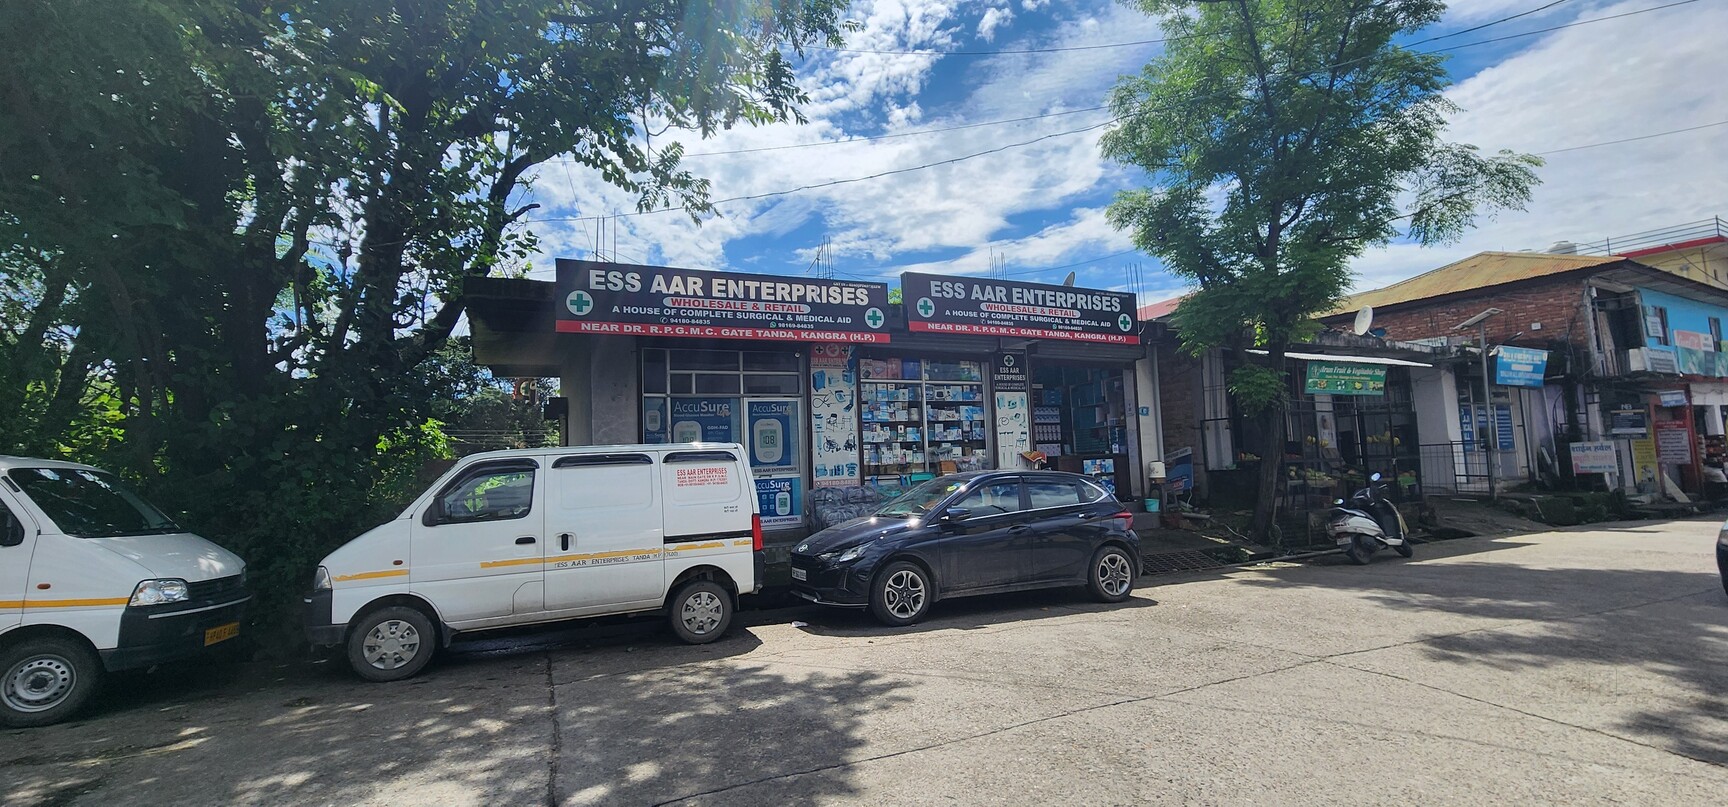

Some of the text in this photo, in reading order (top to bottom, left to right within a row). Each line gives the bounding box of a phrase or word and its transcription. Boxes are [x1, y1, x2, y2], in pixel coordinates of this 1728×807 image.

[589, 270, 869, 306] ESS AAR ENTERPRISES
[930, 280, 1120, 312] ESS AAR ENTERPRISES
[670, 298, 747, 310] WHOLESALE
[764, 304, 804, 312] RETAIL
[985, 304, 1038, 314] WHOLESALE
[1048, 309, 1076, 317] RETAIL
[623, 306, 660, 315] HOUSE
[680, 310, 733, 318] COMPLETE
[736, 312, 783, 321] SURGICAL
[796, 315, 834, 323] MEDICAL
[581, 323, 619, 332] NEAR
[722, 329, 752, 337] GATE
[756, 330, 798, 340] TANDA,
[801, 332, 847, 340] KANGRA
[850, 333, 875, 342] (H.P.)
[674, 401, 729, 412] AccuSure
[752, 404, 792, 412] AccuSure
[757, 480, 790, 489] ccuSure
